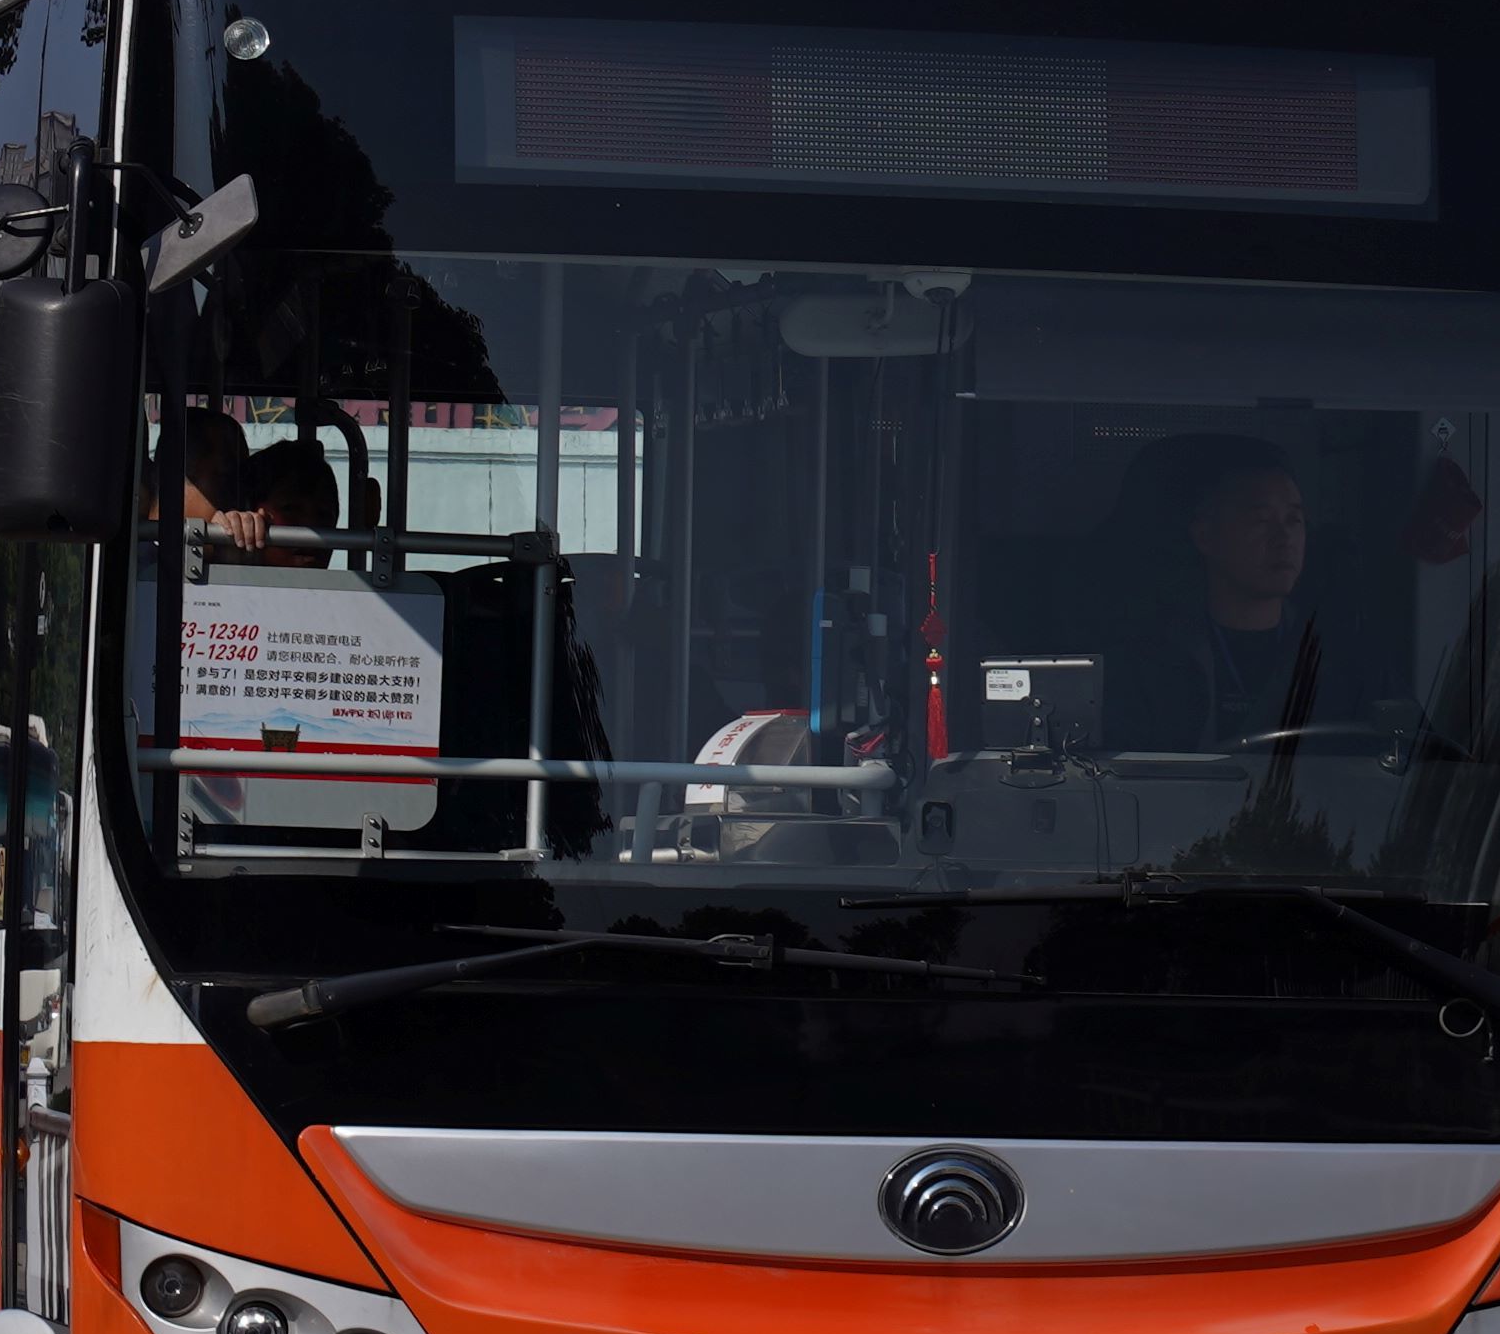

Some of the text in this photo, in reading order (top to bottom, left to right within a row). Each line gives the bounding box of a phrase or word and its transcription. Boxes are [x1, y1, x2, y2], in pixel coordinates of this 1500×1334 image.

[267, 631, 363, 648] 社情民意调查电话
